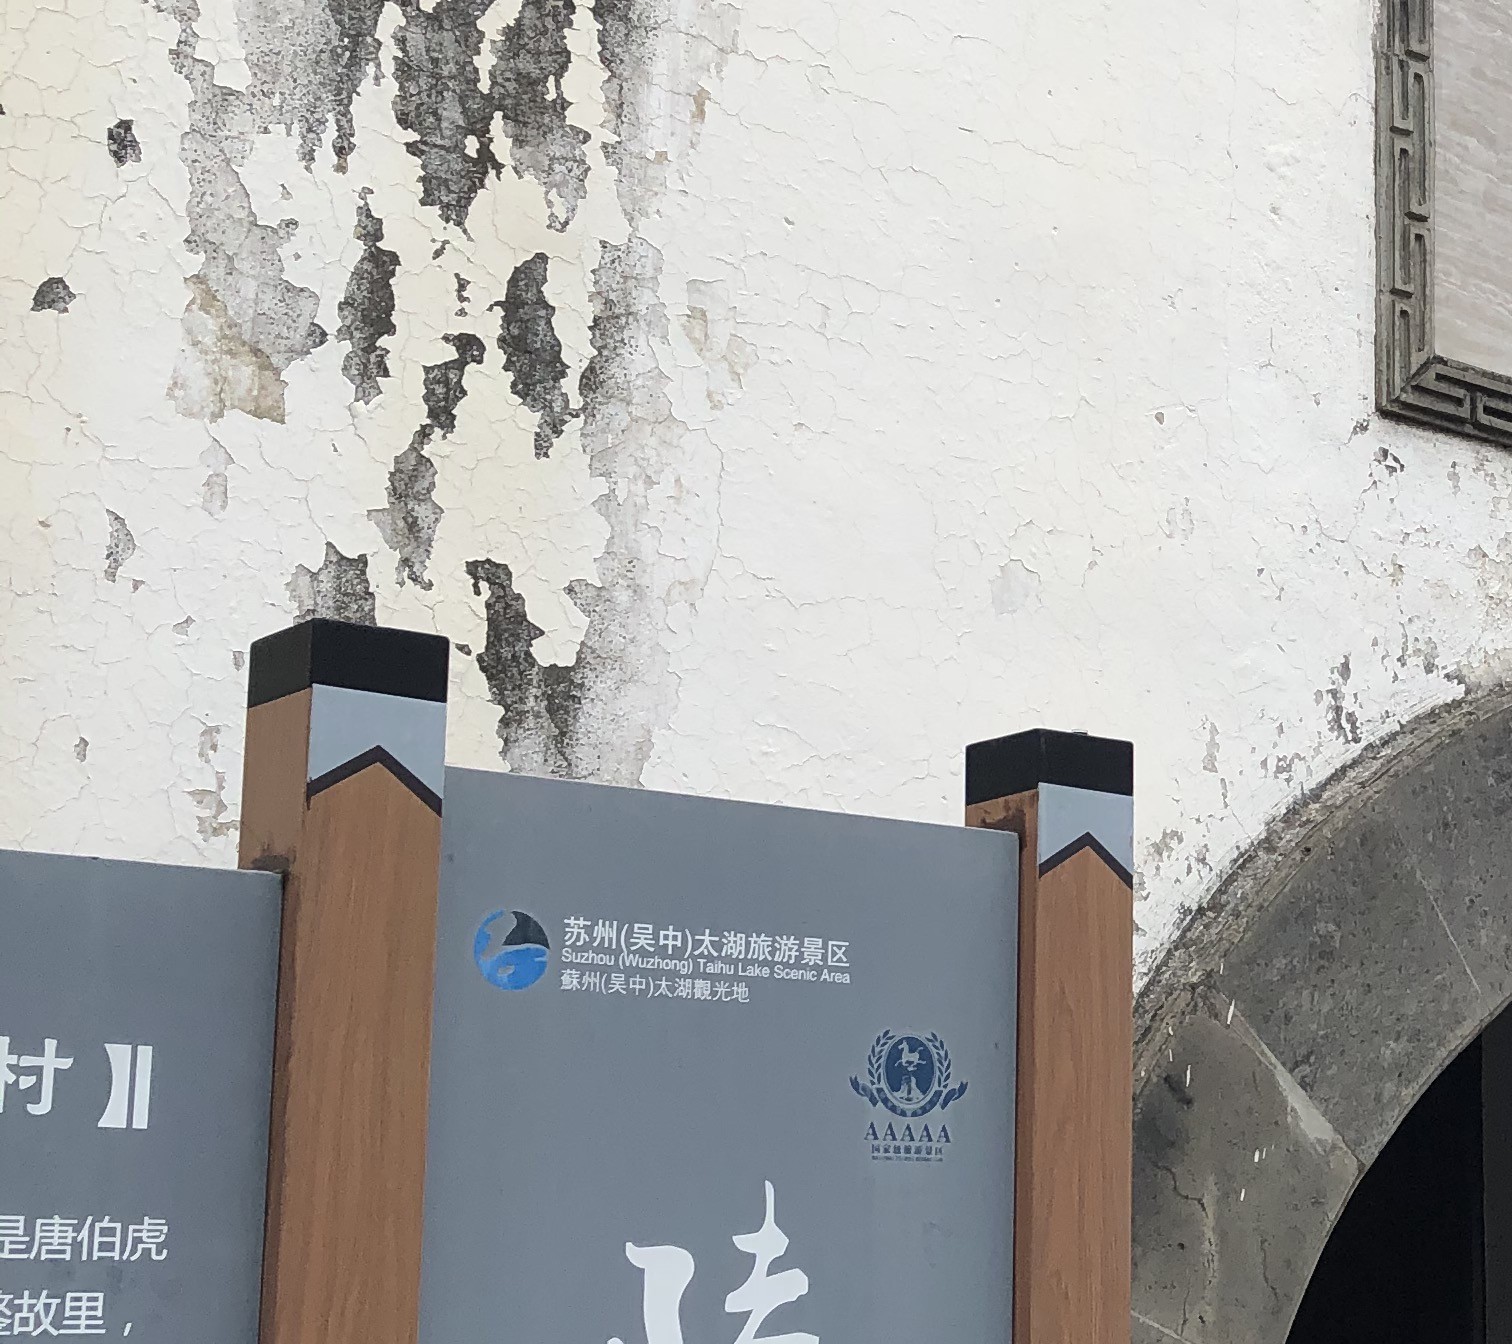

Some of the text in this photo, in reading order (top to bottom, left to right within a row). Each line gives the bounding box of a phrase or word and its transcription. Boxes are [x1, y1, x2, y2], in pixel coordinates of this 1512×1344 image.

[564, 916, 850, 967] 苏州(吴中)太湖旅游景区
[561, 948, 850, 984] Suzhou (Wuzhong) Taihu Lake Scenic Area
[864, 1121, 951, 1143] AAAAA
